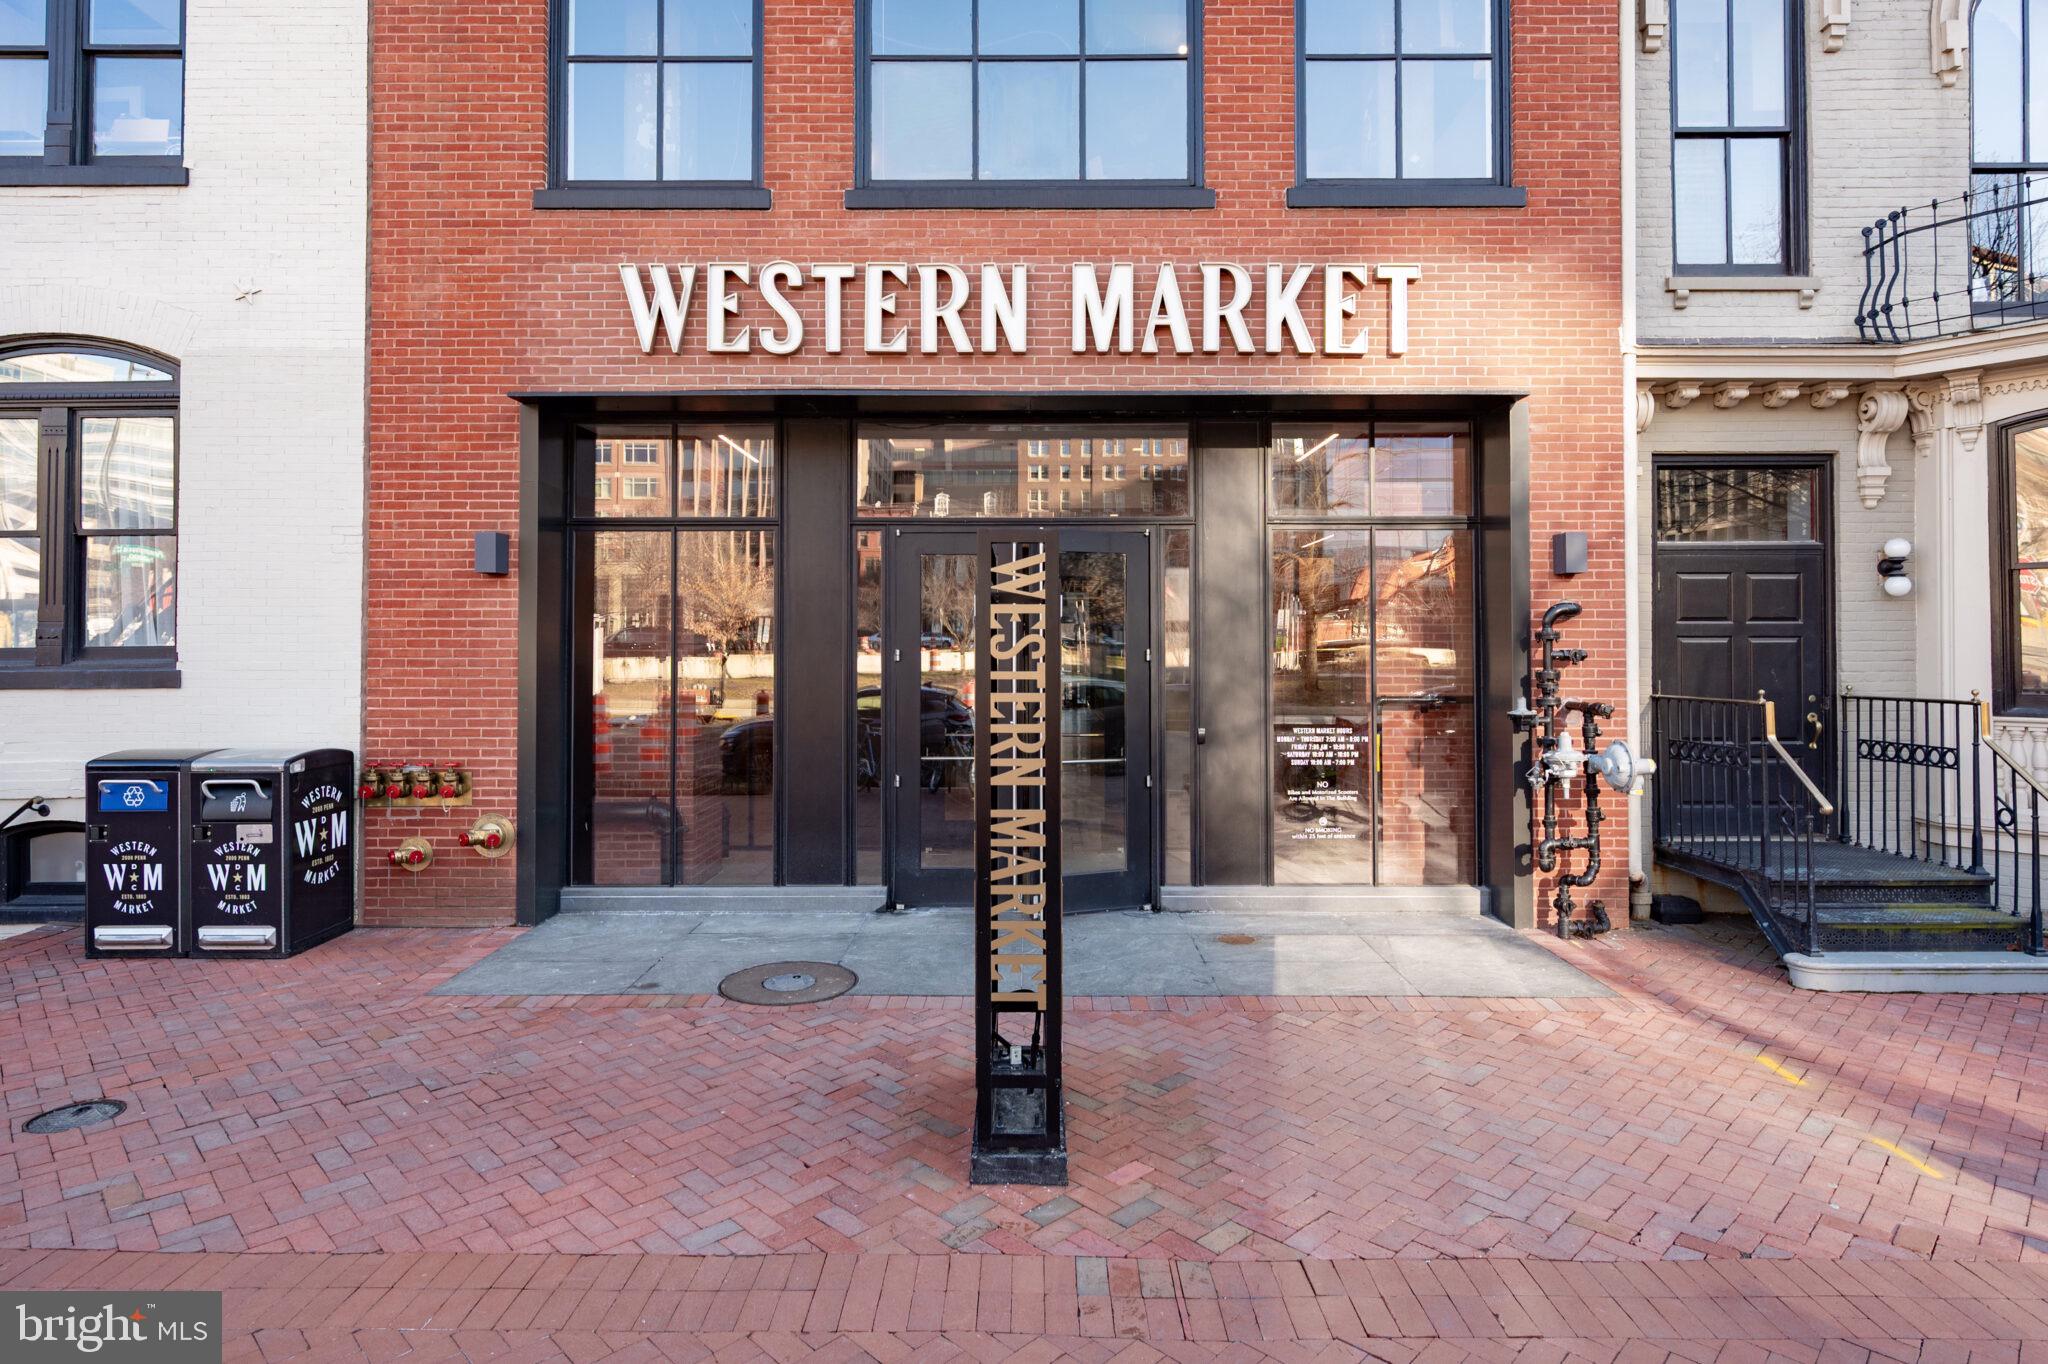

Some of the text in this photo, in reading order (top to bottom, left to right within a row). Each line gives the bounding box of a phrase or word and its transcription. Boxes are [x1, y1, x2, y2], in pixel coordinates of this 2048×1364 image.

[618, 260, 1423, 357] WESTERN MARKET
[990, 553, 1046, 1010] WESTERN MARKET
[301, 786, 342, 808] WESTERN
[324, 803, 334, 811] PENN
[321, 816, 326, 824] D
[295, 810, 346, 858] W M
[110, 841, 157, 856] WESTERN
[214, 841, 260, 857] WESTERN
[321, 844, 326, 852] C
[103, 864, 162, 891] W M
[207, 864, 266, 891] W M
[304, 861, 340, 884] MARKET
[113, 900, 153, 914] MARKET
[217, 900, 257, 914] MARKET
